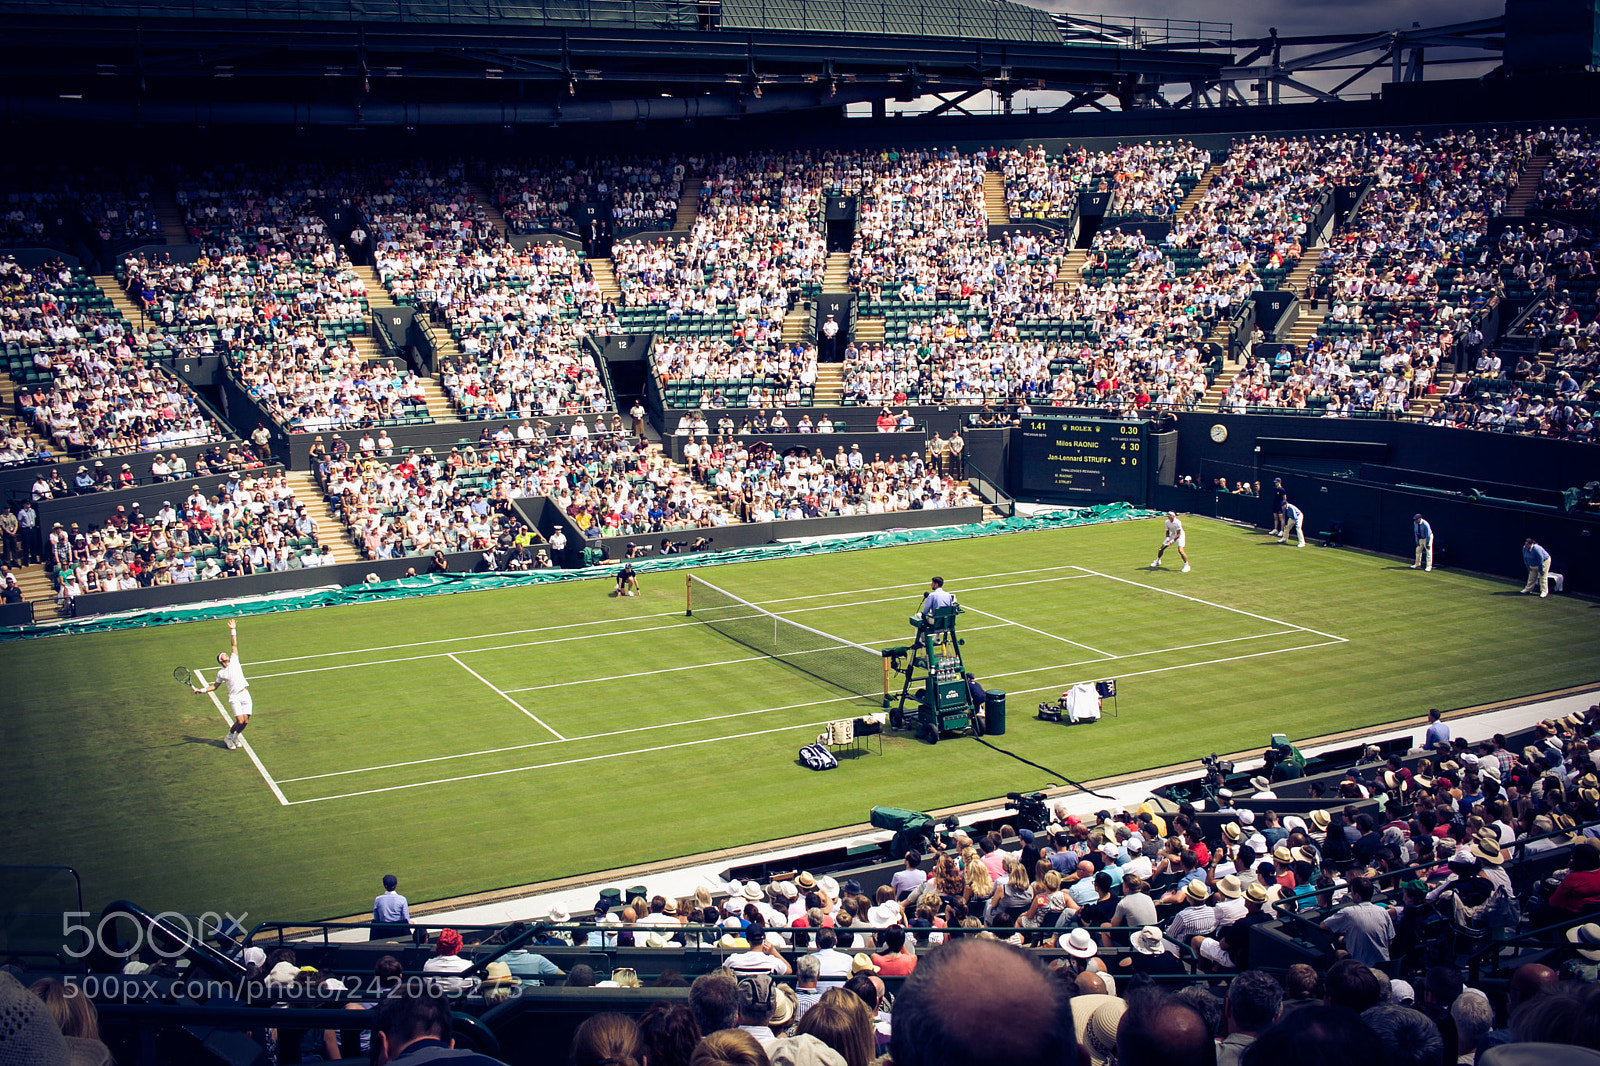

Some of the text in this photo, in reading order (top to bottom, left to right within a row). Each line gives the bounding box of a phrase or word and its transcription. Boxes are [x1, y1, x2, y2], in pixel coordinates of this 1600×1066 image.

[838, 201, 846, 209] 15
[831, 303, 839, 311] 14
[1271, 302, 1280, 310] 16
[392, 317, 401, 325] 10
[618, 341, 627, 349] 12
[184, 364, 190, 372] 8
[1030, 421, 1046, 430] 1.41
[1120, 425, 1138, 435] 0.30
[1056, 439, 1099, 449] Milos RAONIC
[1120, 442, 1140, 451] 4 30
[1047, 453, 1107, 463] Jan-Lennard STRUFF
[1120, 457, 1138, 466] 3 0
